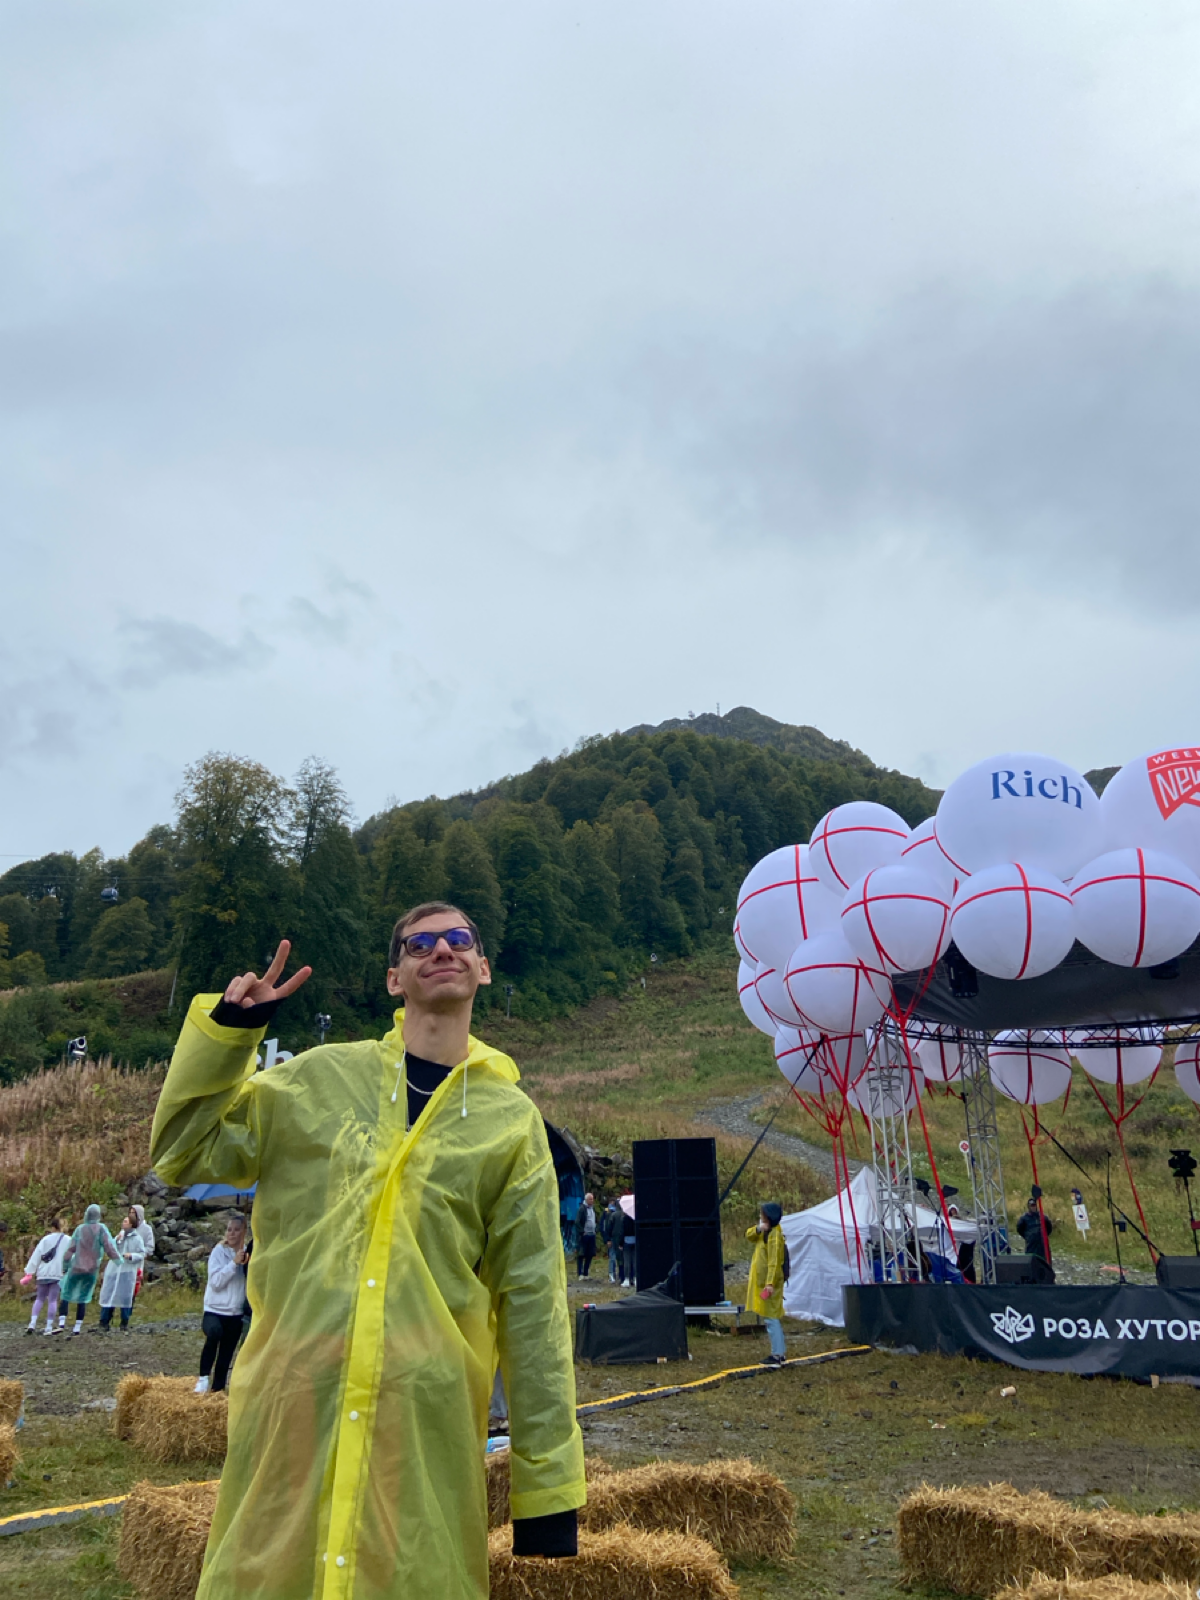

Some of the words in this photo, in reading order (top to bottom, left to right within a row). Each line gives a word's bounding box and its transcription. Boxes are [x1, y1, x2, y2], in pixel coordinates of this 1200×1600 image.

[991, 770, 1083, 810] Rich
[1043, 1318, 1110, 1339] РОЗА
[1116, 1319, 1200, 1341] ХУТОР
